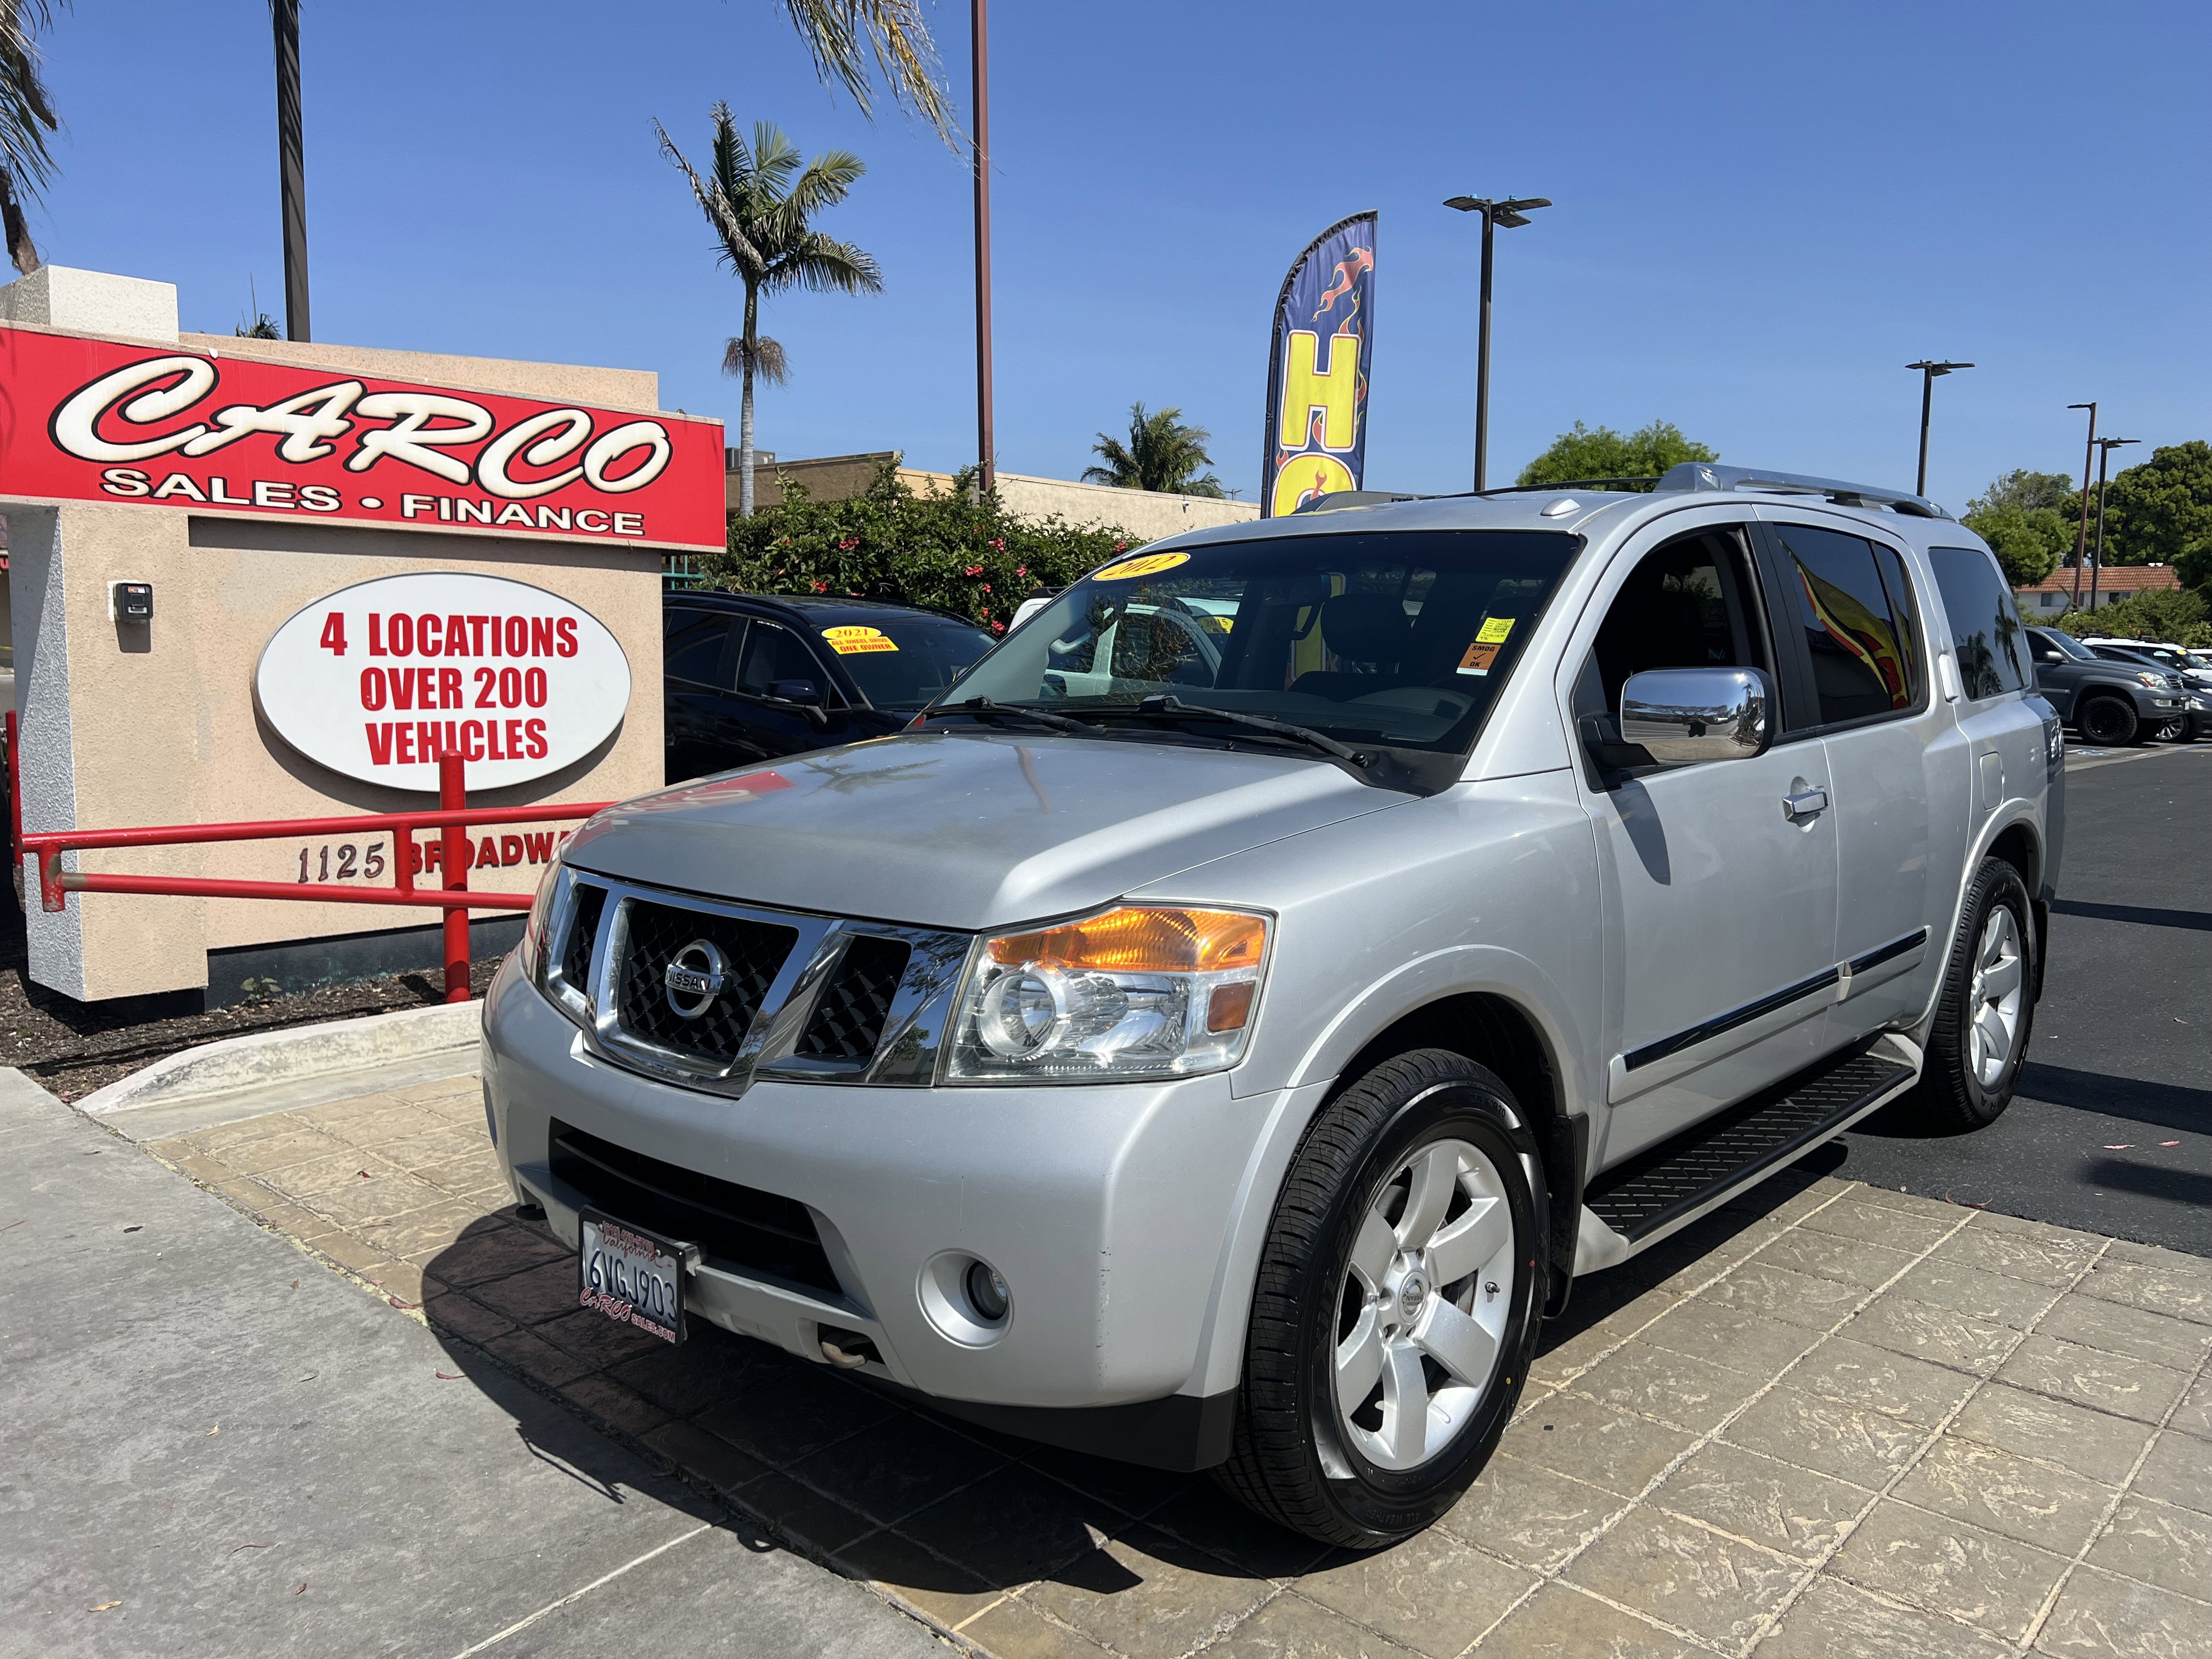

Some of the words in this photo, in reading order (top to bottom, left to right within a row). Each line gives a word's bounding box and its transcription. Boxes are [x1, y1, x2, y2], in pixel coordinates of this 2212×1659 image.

[48, 354, 673, 499] CARCO
[100, 467, 342, 512] SALES
[400, 493, 645, 535] FINANCE
[320, 612, 348, 656] 4
[368, 613, 579, 658] LOCATIONS
[834, 628, 868, 637] 2021
[360, 667, 463, 712] OVER
[473, 667, 548, 709] 200
[364, 718, 549, 765] VEHICLES
[298, 842, 385, 883] 1125
[411, 831, 571, 875] BRADW
[667, 970, 711, 990] NISSAN
[590, 1250, 677, 1322] 6VGJ903
[580, 1286, 632, 1322] CARCO
[631, 1313, 676, 1344] SALES.COM
